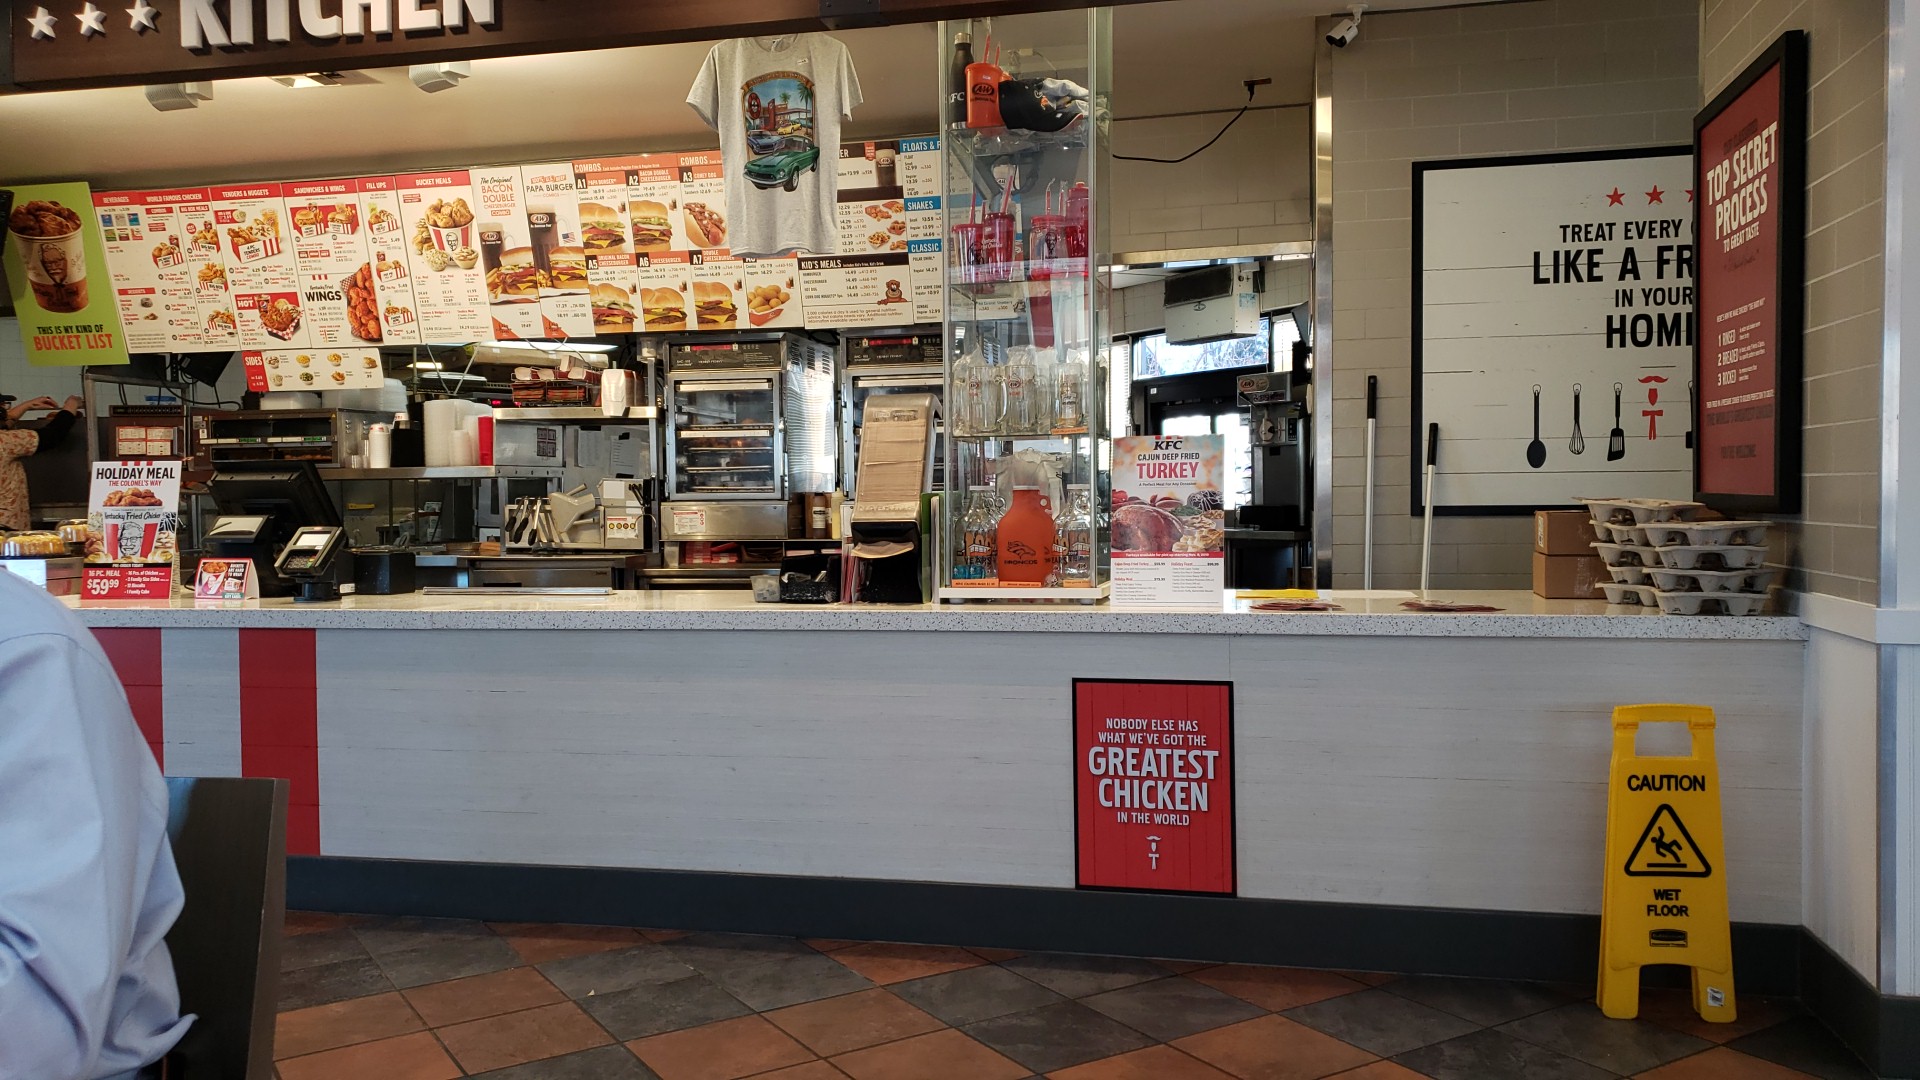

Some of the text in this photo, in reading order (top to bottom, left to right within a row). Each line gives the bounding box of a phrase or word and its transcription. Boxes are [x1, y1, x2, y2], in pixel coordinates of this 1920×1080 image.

[181, 0, 495, 48] KITCHEN
[902, 142, 935, 151] FLOATS &
[840, 150, 849, 158] ER
[680, 156, 708, 166] COMBOS
[1707, 121, 1778, 206] TOP SECRET
[574, 163, 601, 172] COMBOS
[490, 176, 513, 185] Original
[629, 176, 638, 185] A2
[683, 172, 693, 182] A3
[481, 184, 513, 193] BACON
[526, 185, 544, 193] PAPA
[577, 179, 586, 189] A1
[483, 194, 515, 203] DOUBLE
[908, 201, 933, 210] SHAKES
[1716, 173, 1768, 240] PROCESS
[1560, 219, 1683, 243] TREAT EVERY
[1724, 221, 1760, 253] TO GREAT TASTE
[911, 243, 939, 252] CLASSIC
[589, 260, 598, 269] A5
[640, 257, 649, 267] A6
[693, 255, 702, 264] A7
[1534, 244, 1693, 284] LIKE A FR
[801, 260, 819, 270] KID'S
[820, 260, 841, 269] MEALS
[305, 291, 342, 302] WINGS
[1615, 287, 1693, 308] IN YOUR
[37, 324, 103, 334] THIS IS MY KIND OF
[33, 334, 82, 351] BUCKET
[85, 334, 113, 349] LIST
[245, 357, 262, 366] SIDES
[1153, 440, 1184, 450] KFC
[96, 468, 175, 480] HOLIDAY MEAL
[1136, 462, 1199, 479] TURKEY
[1106, 718, 1198, 732] NOBODY ELSE HAS
[1098, 732, 1207, 746] WHAT WE'VE GOT THE
[1088, 746, 1219, 780] GREATEST
[1627, 774, 1706, 792] CAUTION
[1098, 778, 1208, 812] CHICKEN
[1117, 812, 1190, 826] IN THE WORLD
[1653, 889, 1681, 901] WET
[1647, 905, 1689, 917] FLOOR
